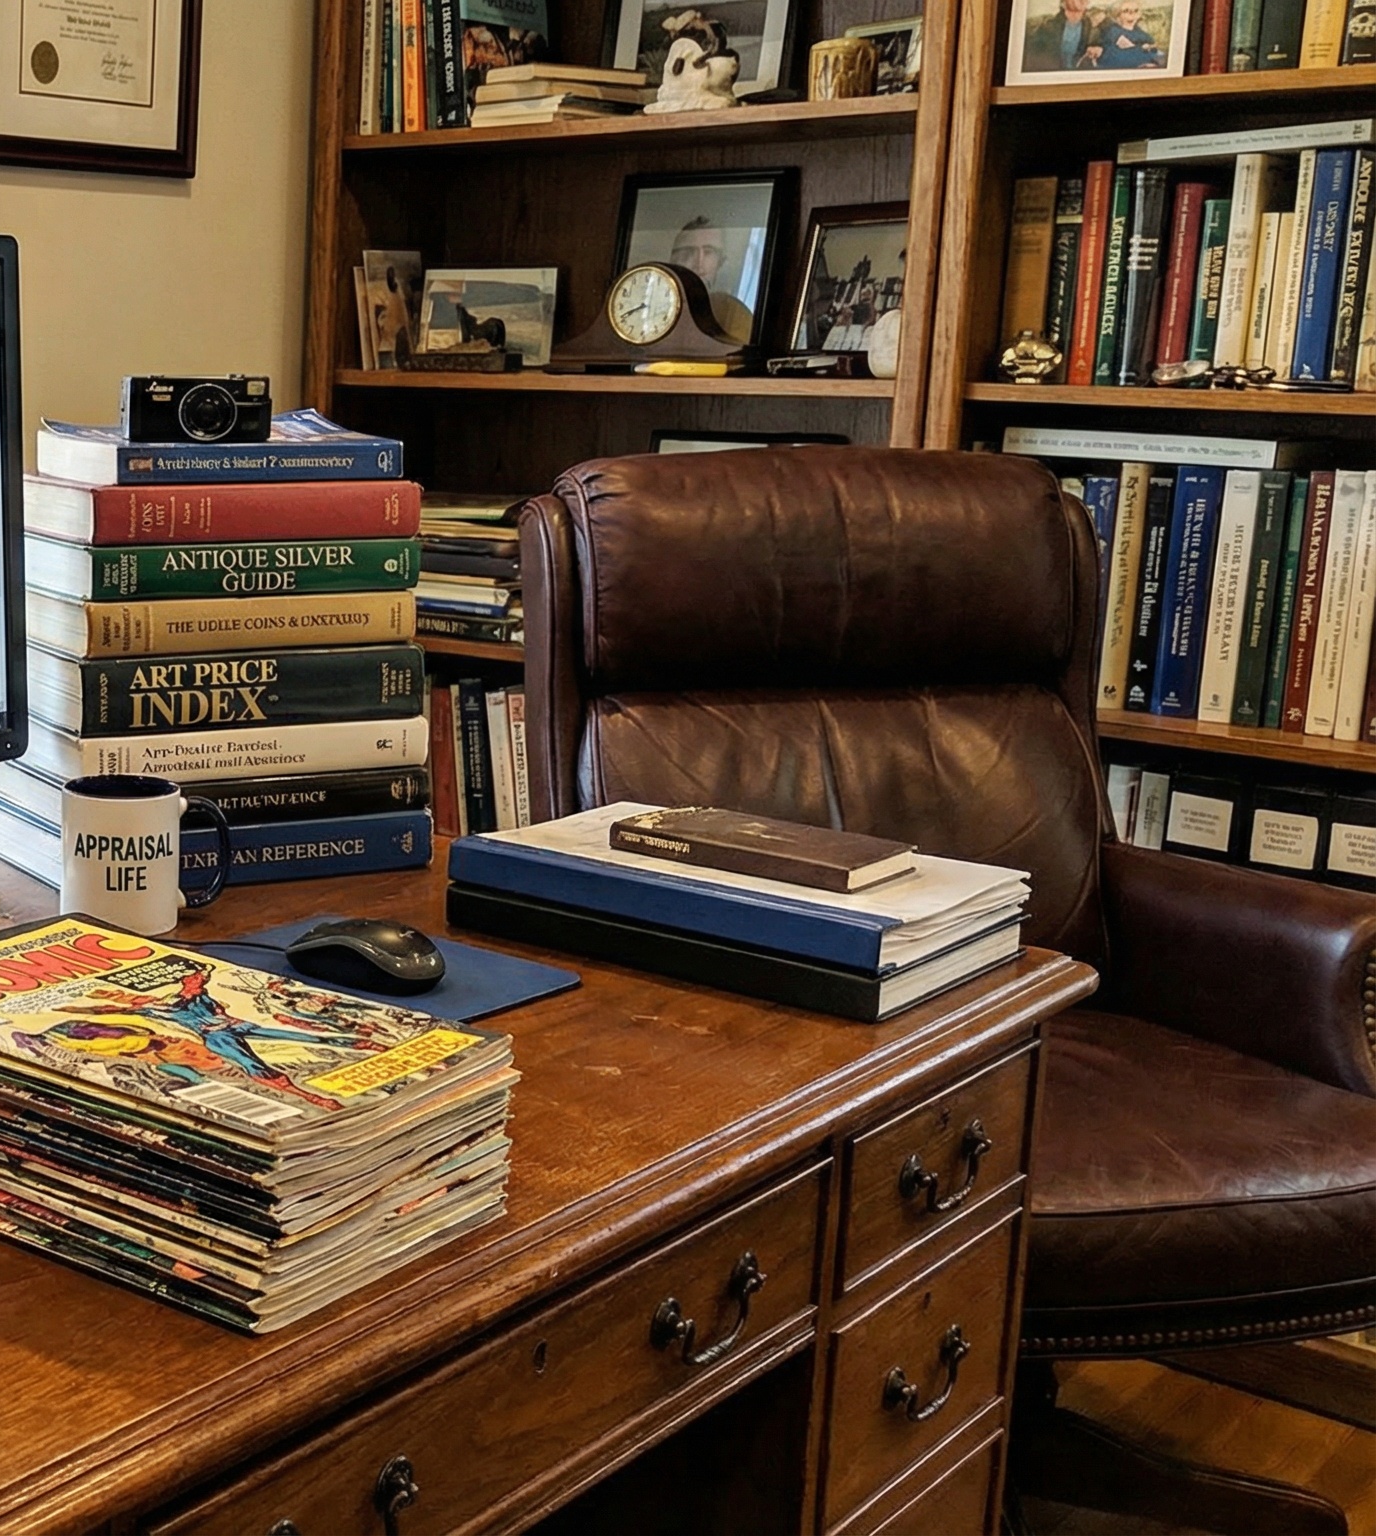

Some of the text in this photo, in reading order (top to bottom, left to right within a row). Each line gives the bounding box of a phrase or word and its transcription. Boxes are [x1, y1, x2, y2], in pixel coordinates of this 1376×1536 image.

[162, 545, 355, 577] ANTIQUE SILVER
[222, 571, 296, 593] GUIDE
[166, 621, 194, 634] THE
[244, 616, 286, 630] COINS
[288, 616, 299, 628] &
[128, 659, 278, 690] ART PRICE
[128, 686, 268, 729] INDEX
[74, 832, 173, 861] APPRAISAL
[262, 839, 365, 862] REFERENCE
[105, 866, 147, 892] LIFE
